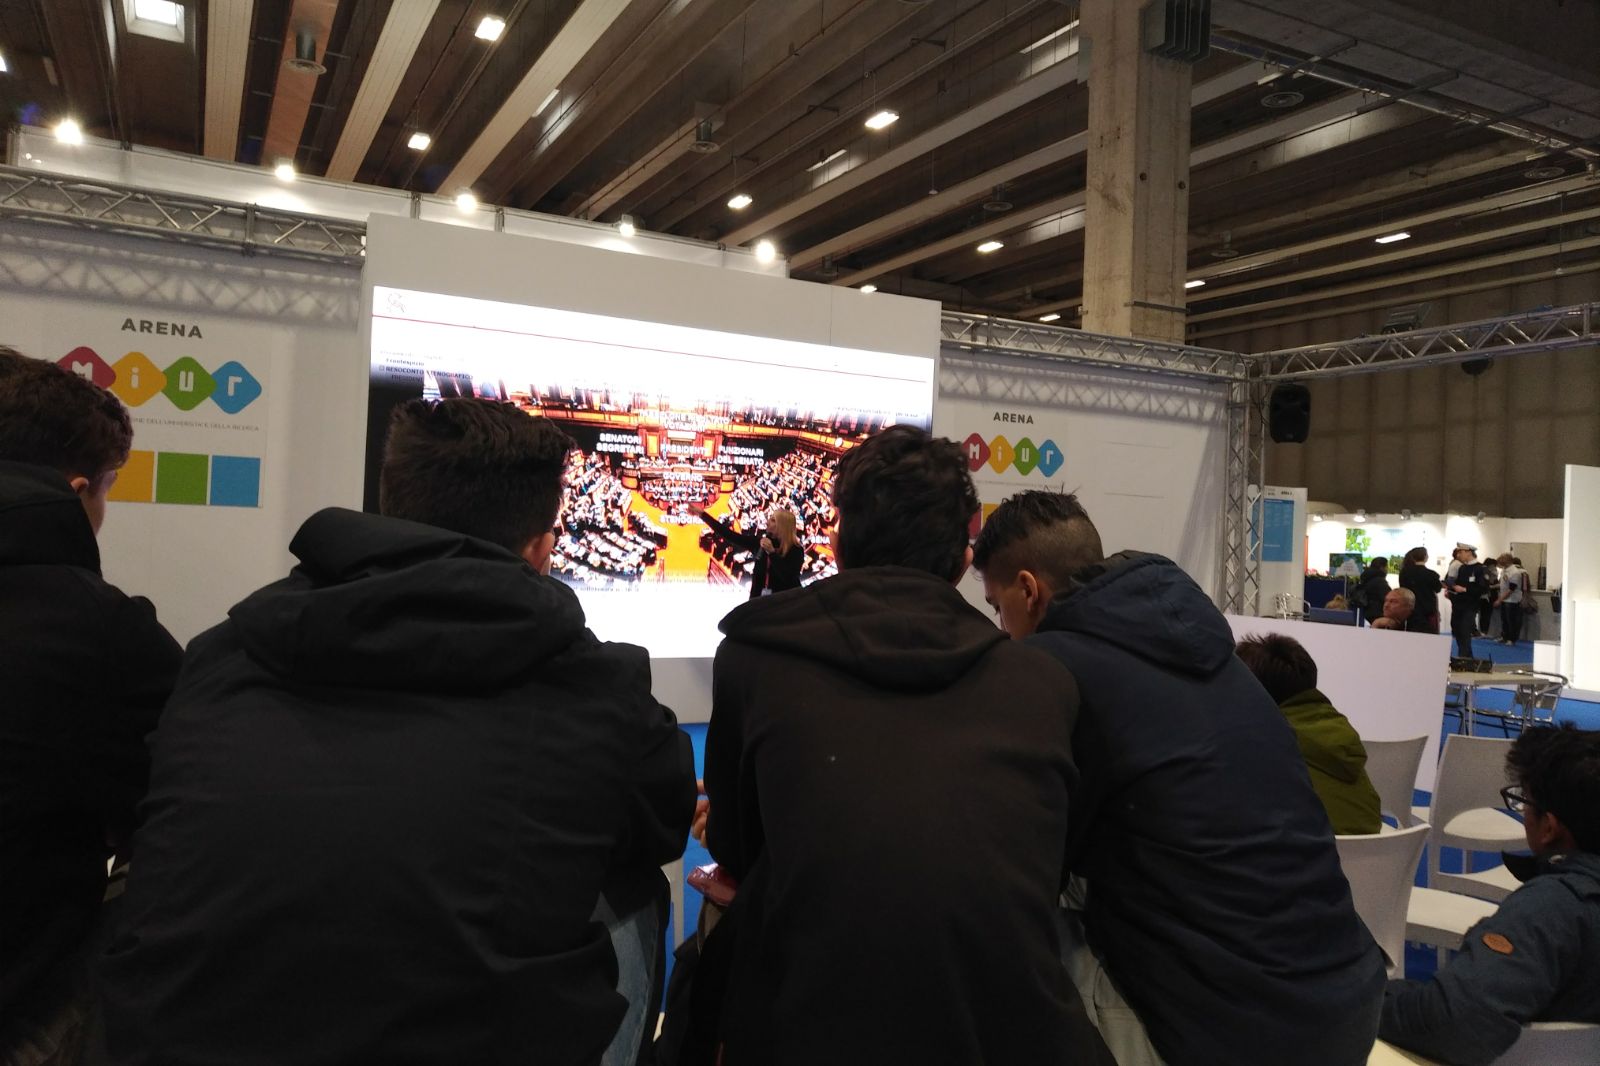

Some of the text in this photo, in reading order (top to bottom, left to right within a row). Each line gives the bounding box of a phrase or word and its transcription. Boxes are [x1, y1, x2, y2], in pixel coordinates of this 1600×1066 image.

[121, 318, 202, 339] ARENA
[993, 411, 1034, 425] ARENA
[599, 433, 642, 445] SENATORI
[596, 442, 645, 455] SEGRETARI
[718, 446, 764, 457] FUNZIONARI
[717, 455, 765, 466] DEL SENATO
[662, 472, 703, 483] GOVERNO
